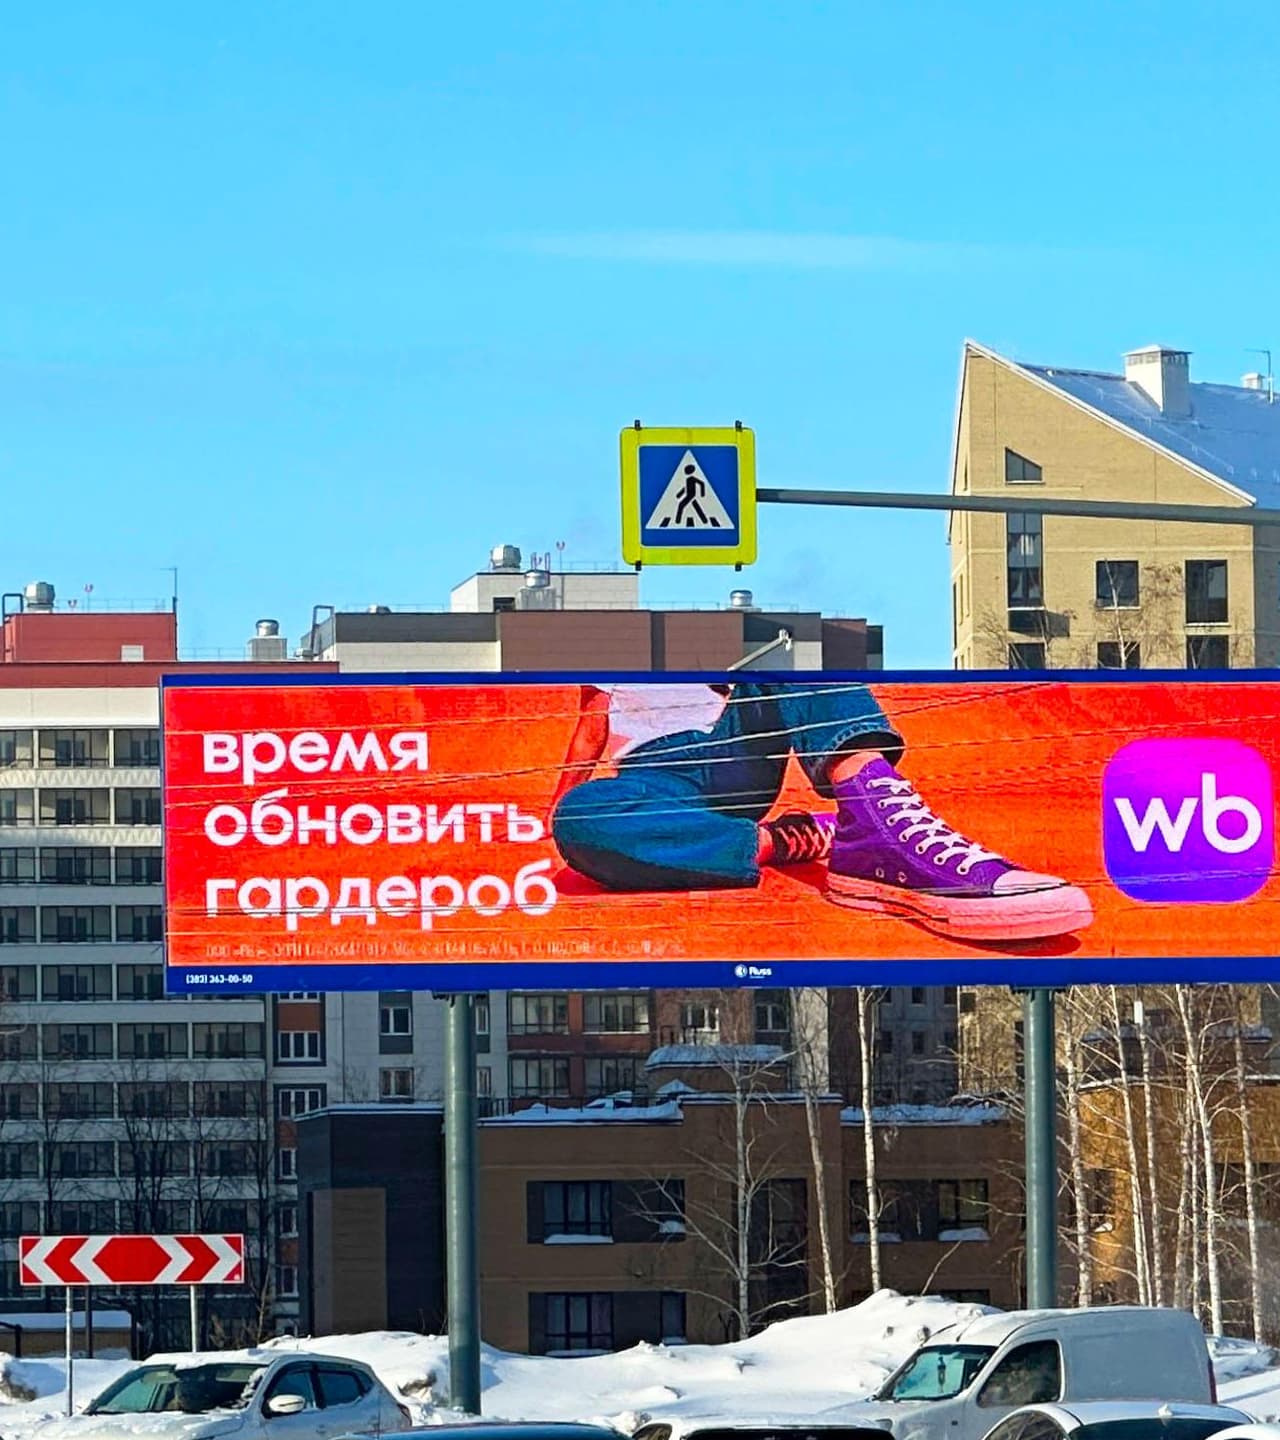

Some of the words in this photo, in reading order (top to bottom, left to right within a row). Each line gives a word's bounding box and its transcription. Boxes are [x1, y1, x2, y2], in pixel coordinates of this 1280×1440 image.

[203, 731, 429, 786] время
[204, 788, 545, 847] обновить
[1113, 772, 1263, 854] wb
[206, 859, 558, 932] гардероб
